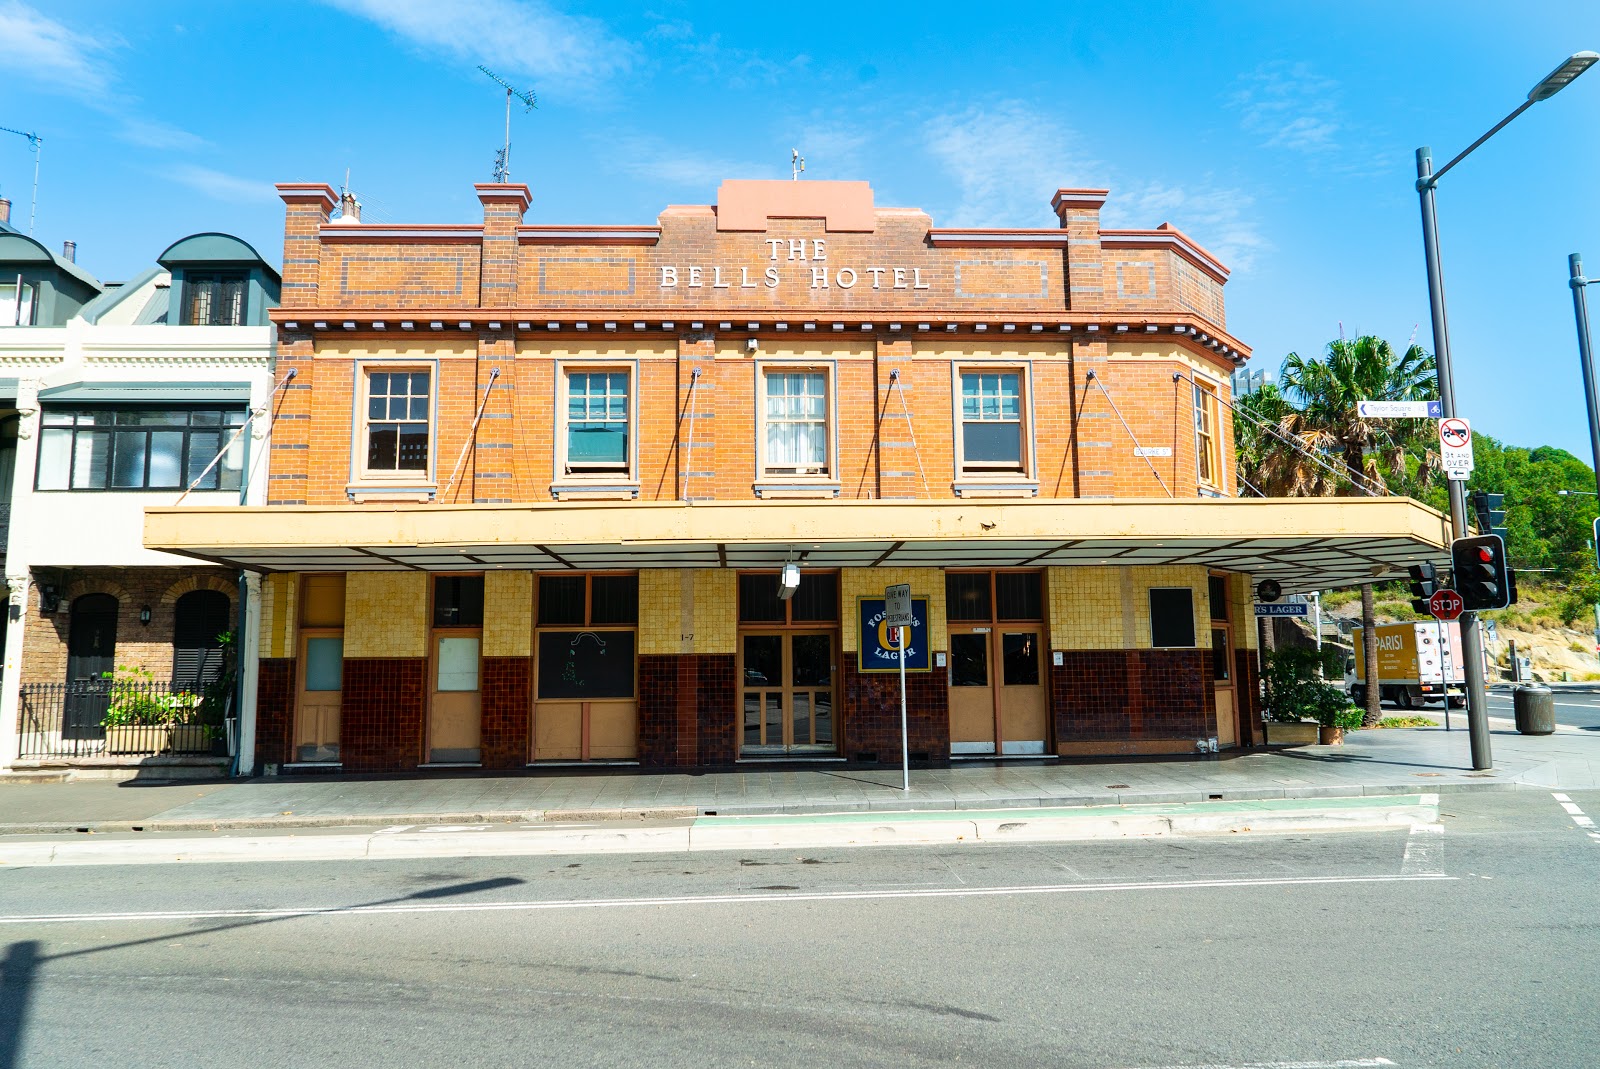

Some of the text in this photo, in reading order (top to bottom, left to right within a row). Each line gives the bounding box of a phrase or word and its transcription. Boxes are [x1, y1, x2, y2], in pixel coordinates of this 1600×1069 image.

[765, 239, 827, 260] THE
[661, 266, 930, 289] BELLS HOTEL
[1369, 404, 1388, 412] Taylor
[1390, 404, 1412, 412] Square
[887, 589, 908, 600] GIVE WAY
[894, 602, 901, 610] TO
[1269, 605, 1303, 613] LAGER
[1432, 599, 1460, 611] STOP
[1374, 634, 1404, 651] PARISI
